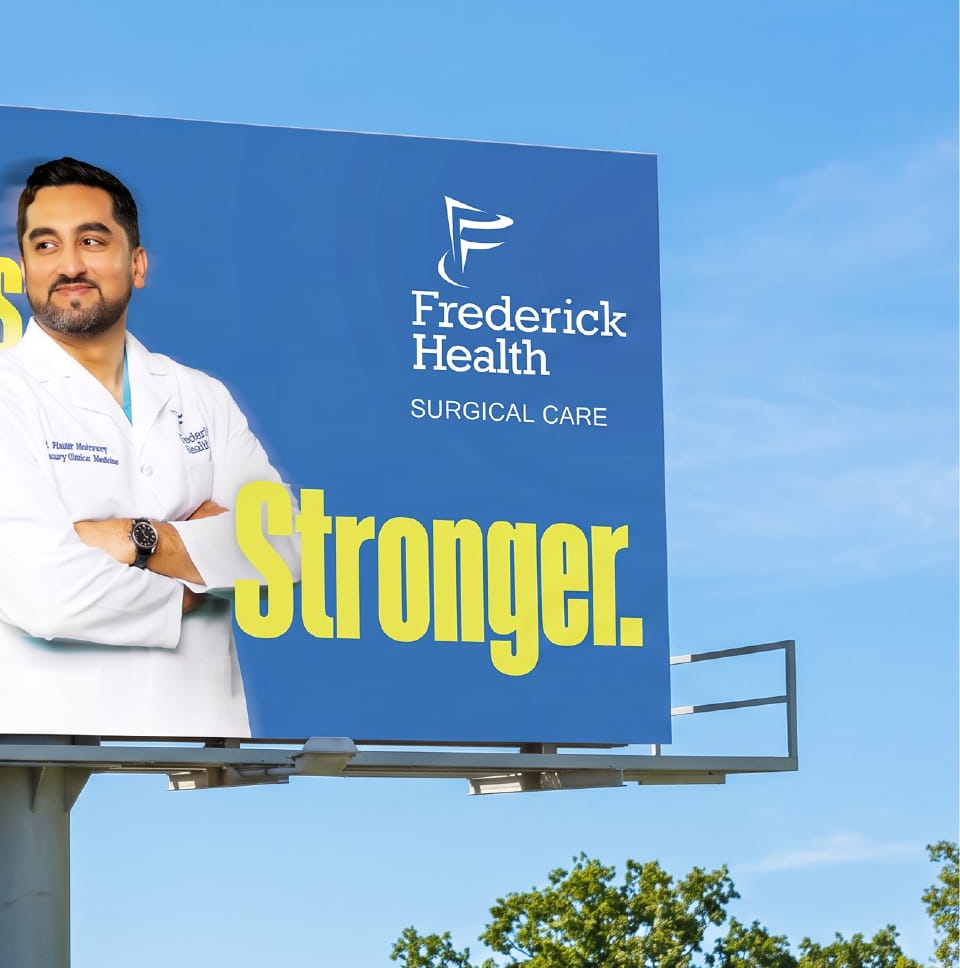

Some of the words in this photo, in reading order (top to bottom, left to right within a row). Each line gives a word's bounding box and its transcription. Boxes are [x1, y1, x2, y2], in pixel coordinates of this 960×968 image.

[411, 290, 628, 338] Frederick
[412, 334, 551, 376] Health
[410, 398, 536, 424] SURGICAL
[541, 405, 608, 428] CARE
[234, 480, 644, 676] Stronger.
